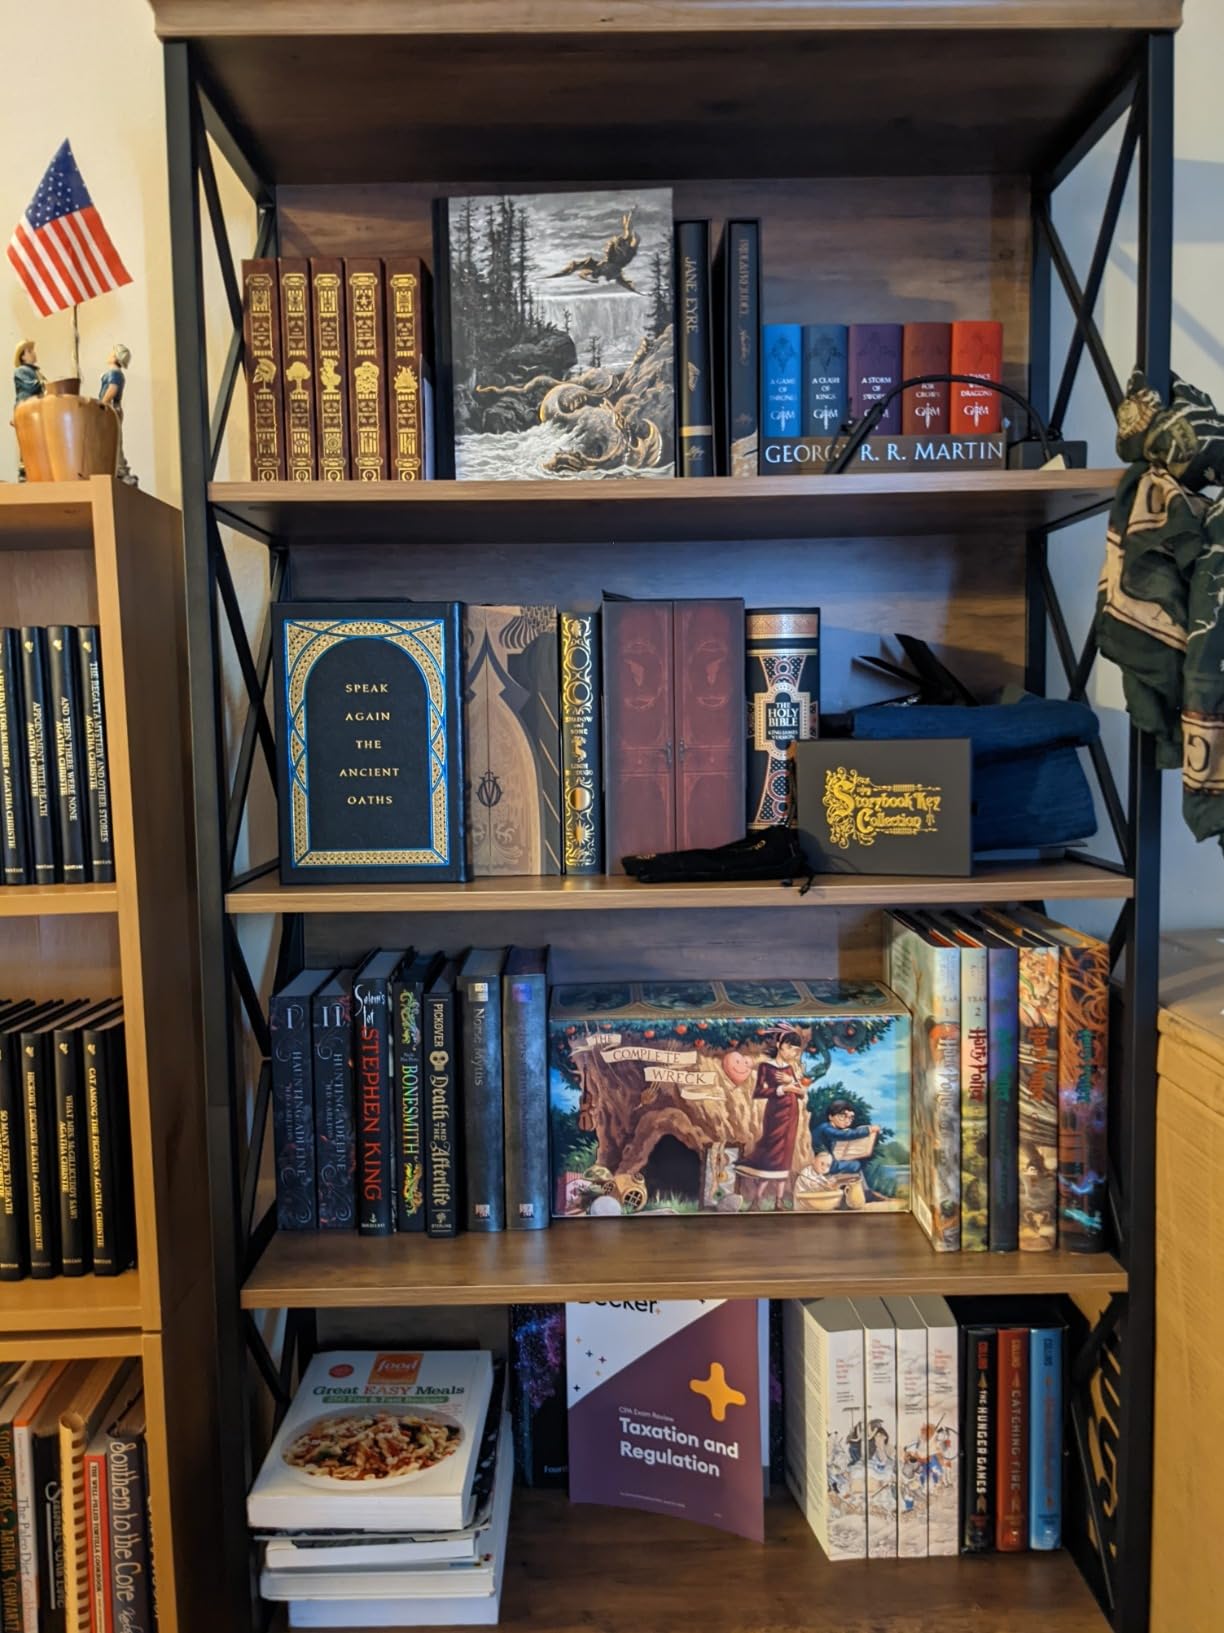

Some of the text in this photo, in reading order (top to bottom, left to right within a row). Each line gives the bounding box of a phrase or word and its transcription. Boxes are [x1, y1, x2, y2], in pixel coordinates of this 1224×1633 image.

[684, 256, 700, 334] JANE EYRE
[765, 442, 1004, 464] GEORG R. R. MARTIN
[345, 683, 389, 693] SPEAK
[0, 713, 8, 730] FOR
[345, 712, 391, 721] AGAIN
[768, 708, 799, 718] HOLY
[768, 717, 799, 727] BIBLE
[1, 731, 10, 768] MURDER
[27, 722, 39, 797] AGATHA CHRISTIE
[32, 702, 48, 816] APPOINTMENT WITH DEATH
[55, 721, 68, 796] AGATHA CHRISTIE
[61, 696, 78, 821] AND THEN THERE WERE NONE
[85, 715, 98, 790] AGATHA CHRISTIE
[90, 661, 109, 843] THE REGATTA MYSTERY AND OTHER STORIES
[355, 740, 382, 749] THE
[339, 767, 400, 777] ANCIENT
[3, 774, 13, 810] AGATHA
[347, 795, 393, 805] OATHS
[833, 780, 941, 816] Storybook Key
[6, 810, 16, 849] CHRISTIE
[856, 808, 922, 834] Collection
[433, 1003, 444, 1048] PICKOVER
[593, 1034, 612, 1046] THE
[471, 1008, 486, 1086] Norse Myths
[613, 1049, 681, 1064] COMPLETE
[968, 1029, 988, 1102] Harry Potter
[361, 1026, 382, 1131] STEPHEN
[652, 1069, 707, 1084] WRECK
[65, 1095, 74, 1119] WHAT
[292, 1051, 306, 1177] HAUNTING ADELINE
[333, 1053, 346, 1171] HUNTING ADELINE
[402, 1064, 420, 1154] BONESMITH
[430, 1074, 450, 1120] Death
[0, 1110, 13, 1215] SO MANY STEPS TO DEATH
[27, 1071, 43, 1250] HICKORY DICKORY DEATH AGATHA CHRISTIE
[59, 1121, 69, 1193] AGATHA CHRISTIE
[89, 1067, 104, 1249] CAT AMONG THE PIGEONS AGATHA CHRISTIE
[363, 1142, 384, 1201] KING
[430, 1141, 451, 1206] Afterlife
[578, 1299, 657, 1313] cker
[378, 1359, 418, 1374] food
[313, 1384, 465, 1396] Great EASY Meals
[619, 1406, 675, 1422] CPA Exam Review
[619, 1417, 739, 1459] Taxation and
[977, 1390, 988, 1493] THE HUNGER GAMES
[1011, 1390, 1021, 1490] CATCHING FIRE
[110, 1442, 139, 1510] Southern
[620, 1441, 720, 1477] Regulation
[18, 1496, 30, 1519] The
[113, 1513, 139, 1531] to
[0, 1430, 19, 1632] SOUP SUPPERS ARTHUR SCHWARTZ
[19, 1522, 33, 1550] Paleo
[113, 1533, 141, 1559] the
[20, 1552, 32, 1575] Diet
[115, 1562, 142, 1602] Core
